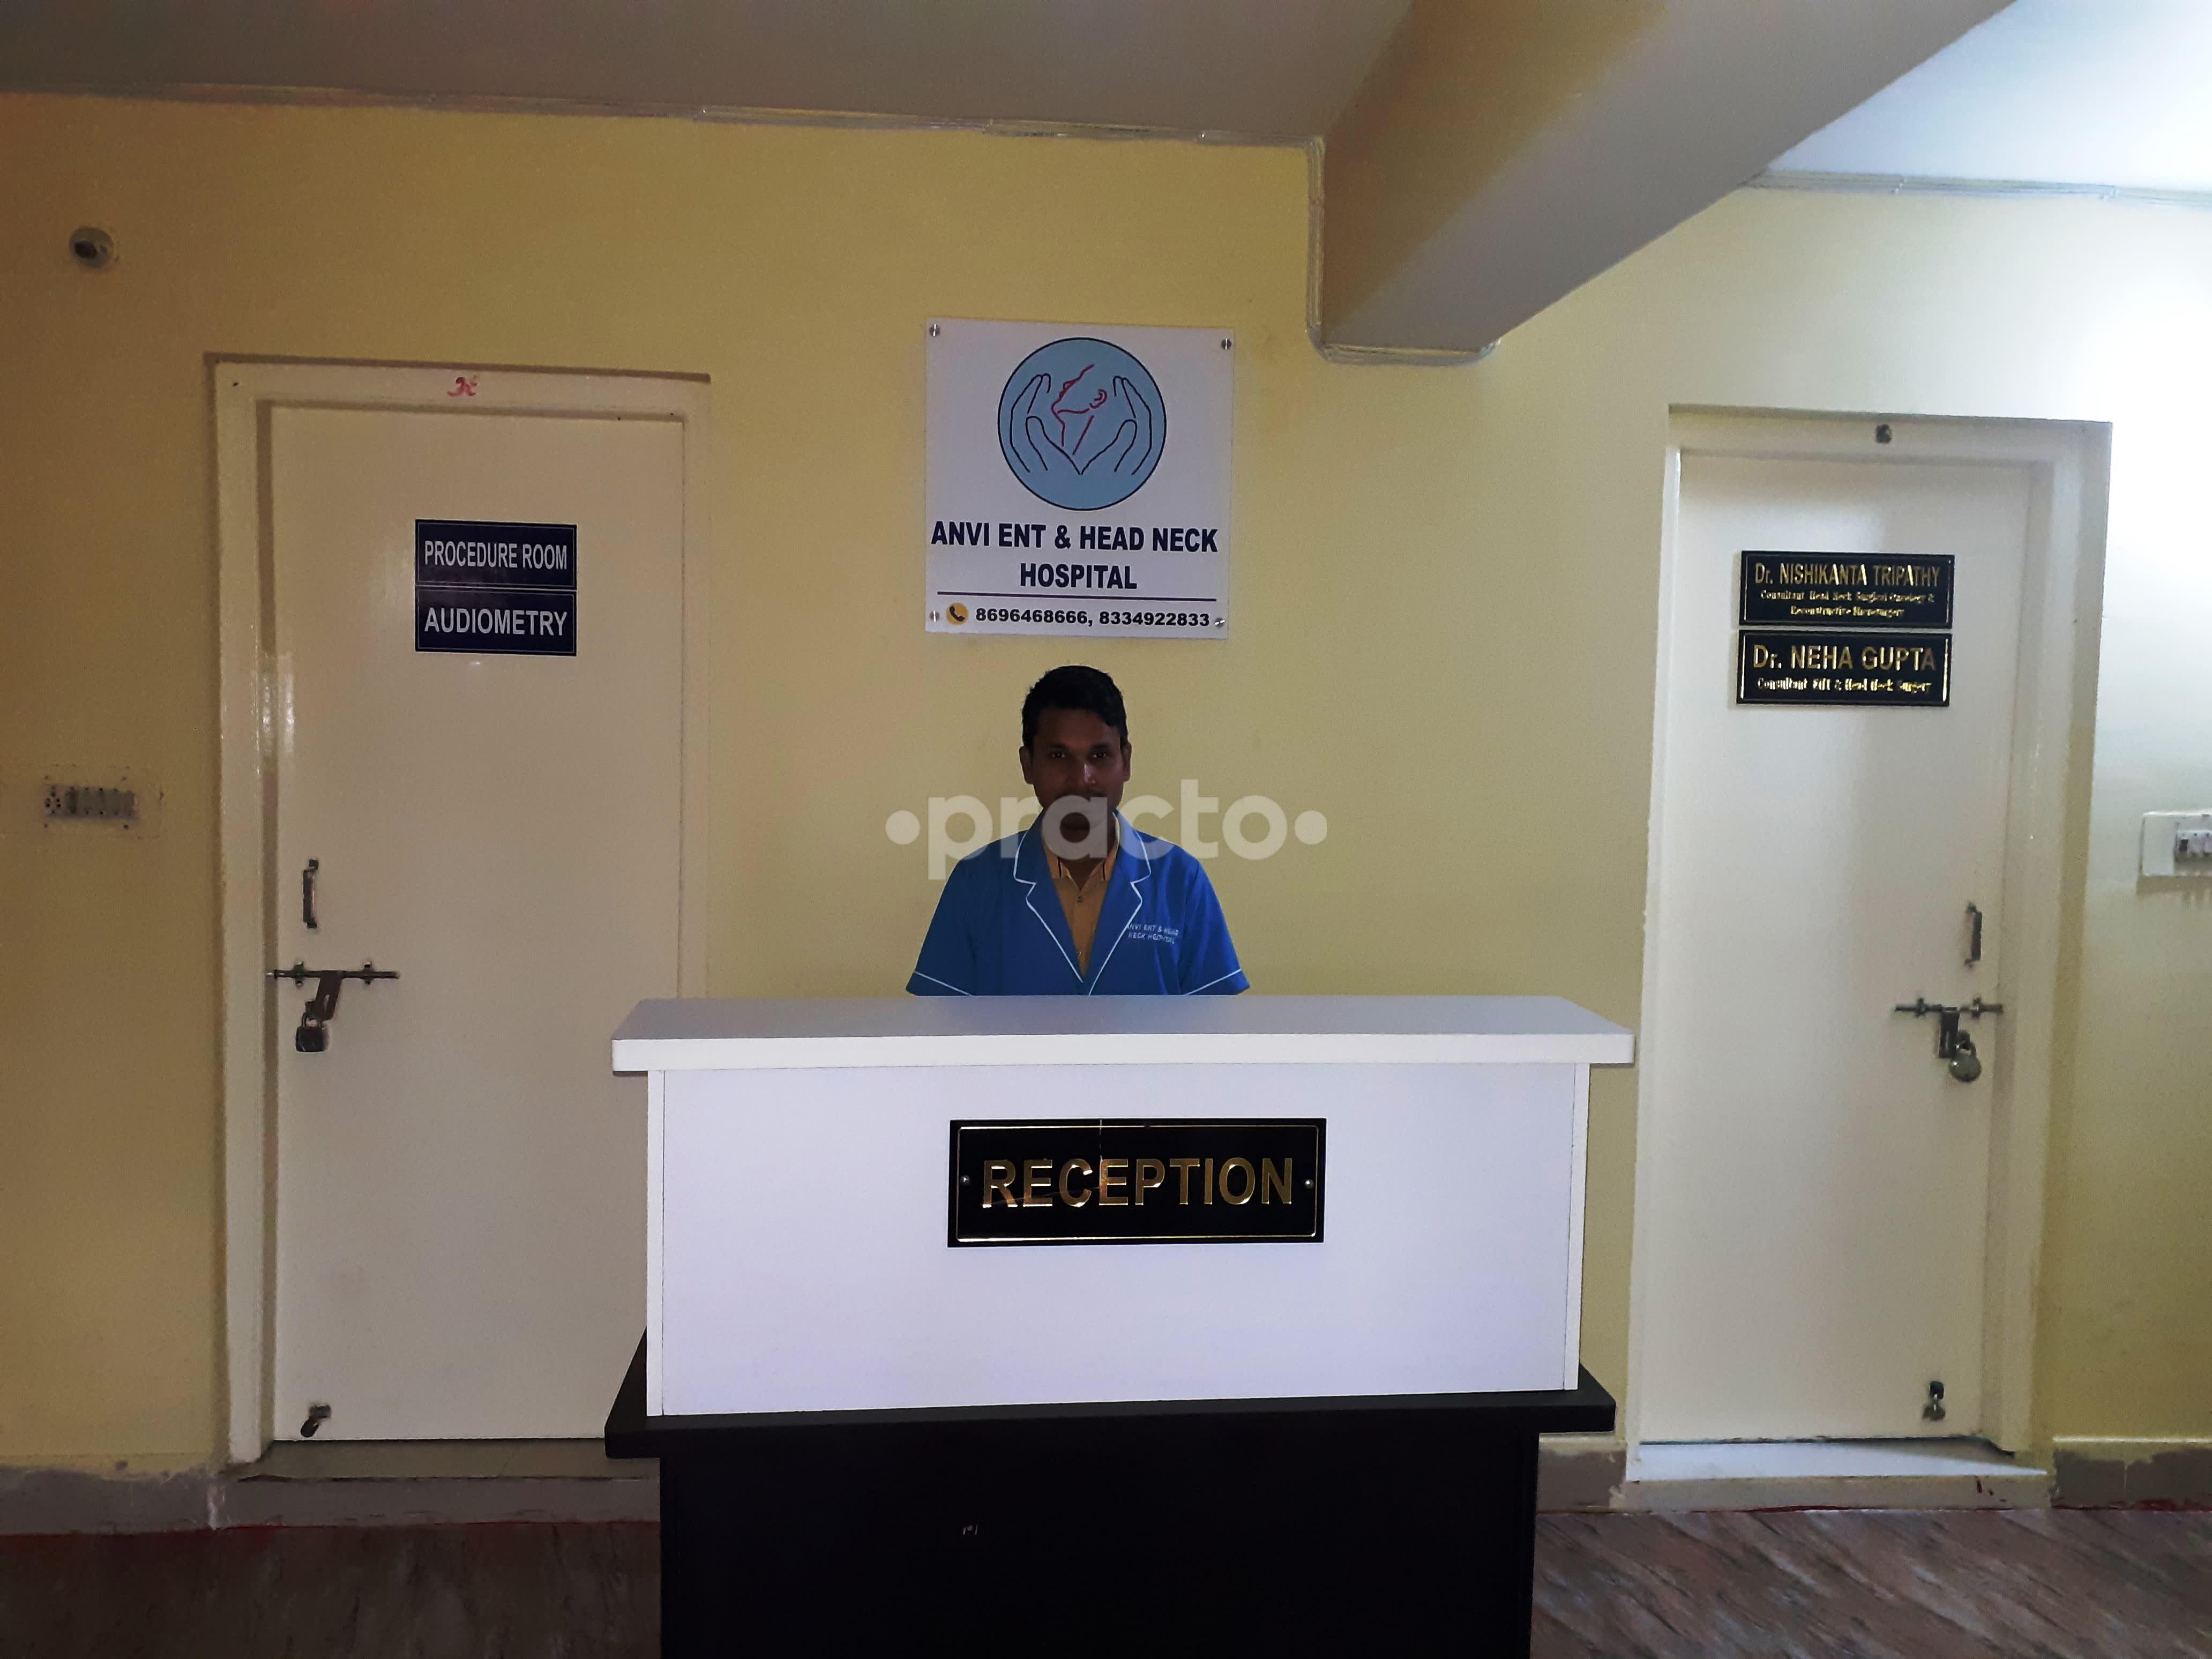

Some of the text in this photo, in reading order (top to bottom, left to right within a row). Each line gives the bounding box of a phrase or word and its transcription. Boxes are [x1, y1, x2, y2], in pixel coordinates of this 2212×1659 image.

[931, 520, 1219, 553] ANVI ENT & HEAD NECK
[424, 540, 567, 570] PROCEDURE ROOM
[1020, 563, 1138, 589] HOSPITAL
[1755, 563, 1940, 586] Dr. NISHIKANTA TRIPATHY
[424, 607, 568, 636] AUDIOMETRY
[975, 608, 1210, 627] 8696468666, 8334922833
[1753, 645, 1936, 671] Dr. NEHA GUPTA
[1758, 677, 1808, 690] Consultant
[1163, 927, 1179, 936] HEAD
[982, 1156, 1294, 1209] RECEPTION
